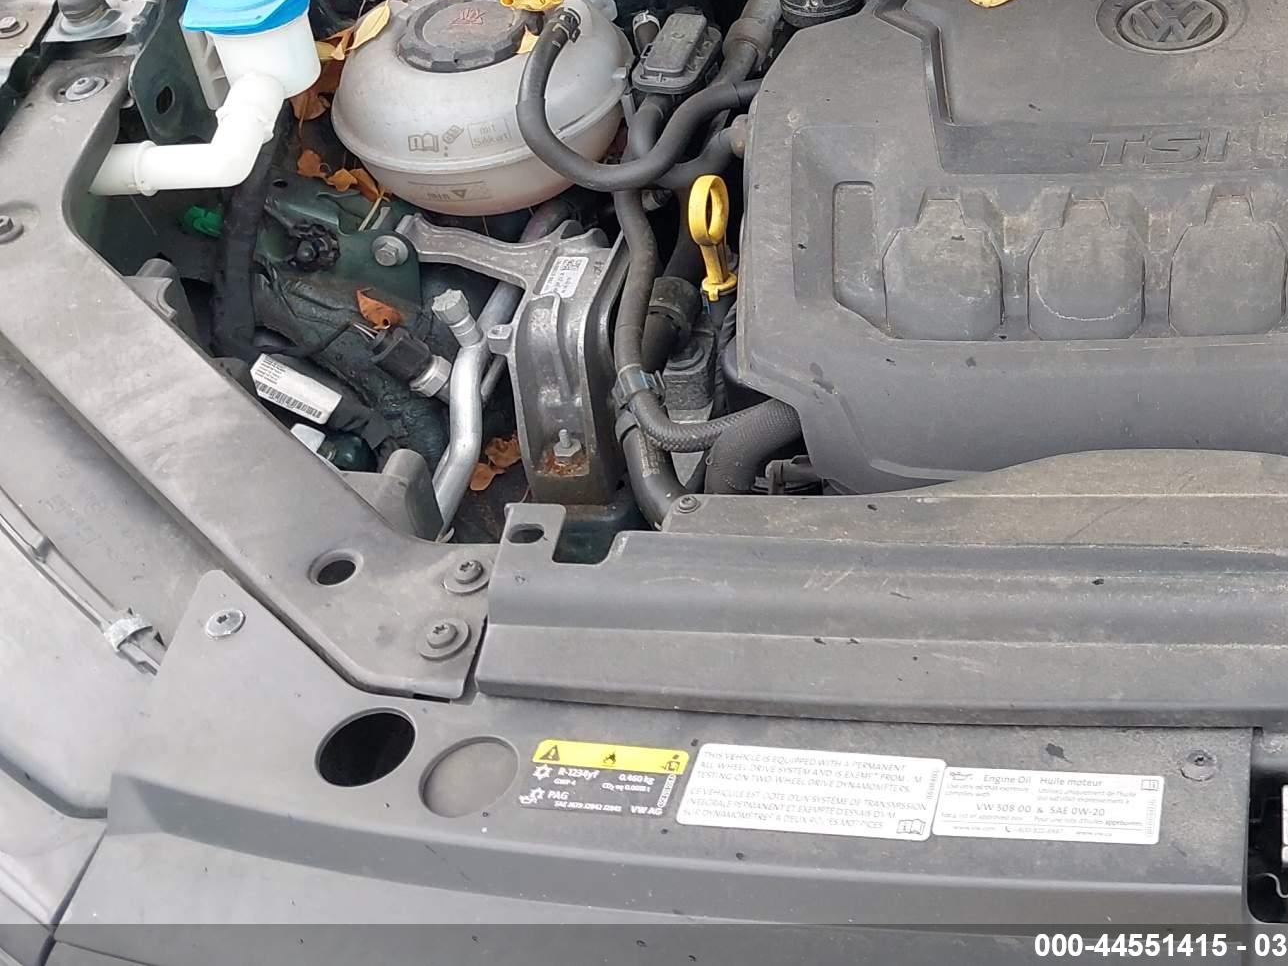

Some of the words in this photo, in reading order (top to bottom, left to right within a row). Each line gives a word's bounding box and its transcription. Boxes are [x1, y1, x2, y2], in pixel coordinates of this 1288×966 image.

[1089, 129, 1231, 167] TSI
[818, 758, 841, 766] WITH
[984, 774, 1016, 784] Engine
[1018, 776, 1032, 784] Oil
[1040, 777, 1065, 785] Huile
[1067, 778, 1102, 786] moteur
[548, 790, 569, 800] PAG
[630, 805, 648, 814] VW
[648, 807, 663, 816] AG
[976, 802, 993, 811] VW
[1017, 804, 1032, 813] 00
[1050, 806, 1068, 814] SAE
[1072, 808, 1106, 816] 0W-20
